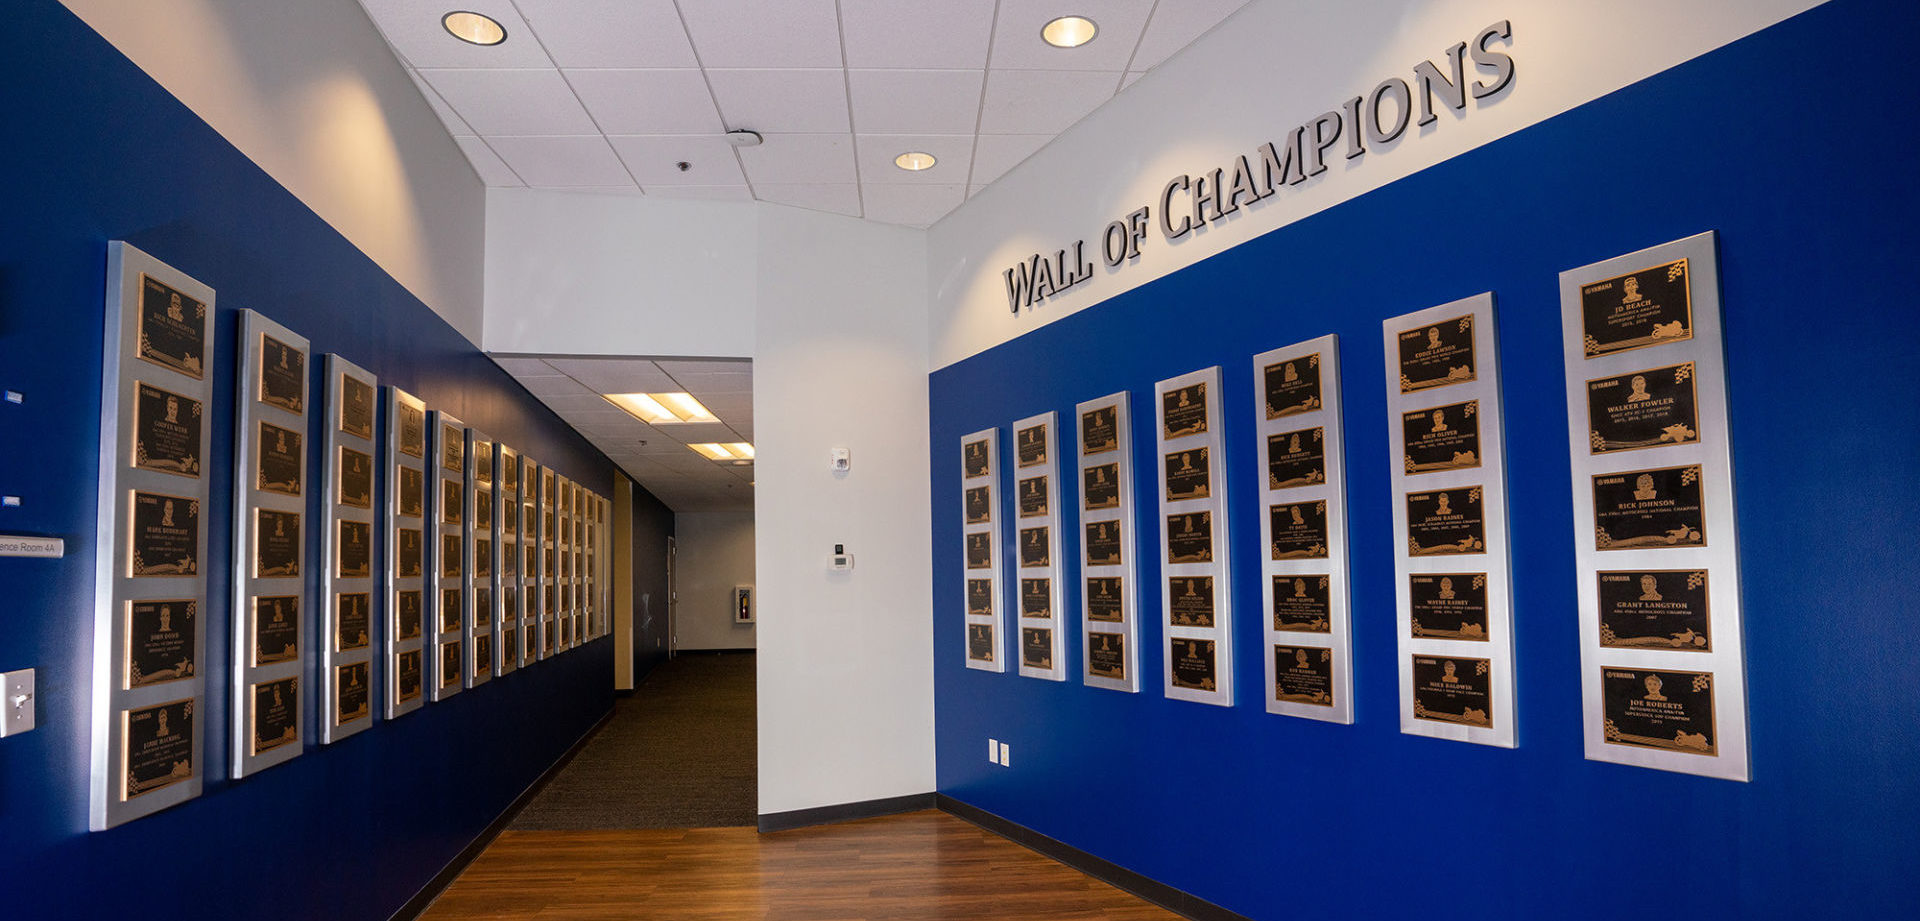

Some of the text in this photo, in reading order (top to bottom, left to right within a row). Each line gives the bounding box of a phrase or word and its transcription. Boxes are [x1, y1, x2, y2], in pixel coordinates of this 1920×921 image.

[1002, 19, 1515, 313] WALL OF CHAMPIONS
[1615, 299, 1651, 313] JD BEACH
[1432, 344, 1455, 354] LAWSON
[1607, 397, 1673, 412] WALKER FOWLER
[1437, 430, 1457, 438] OLIVER
[1639, 499, 1674, 508] JOHNSON
[20, 542, 43, 553] Room
[45, 544, 55, 552] 4A
[1445, 682, 1472, 690] BALDWIN
[1646, 700, 1682, 710] ROBERTS
